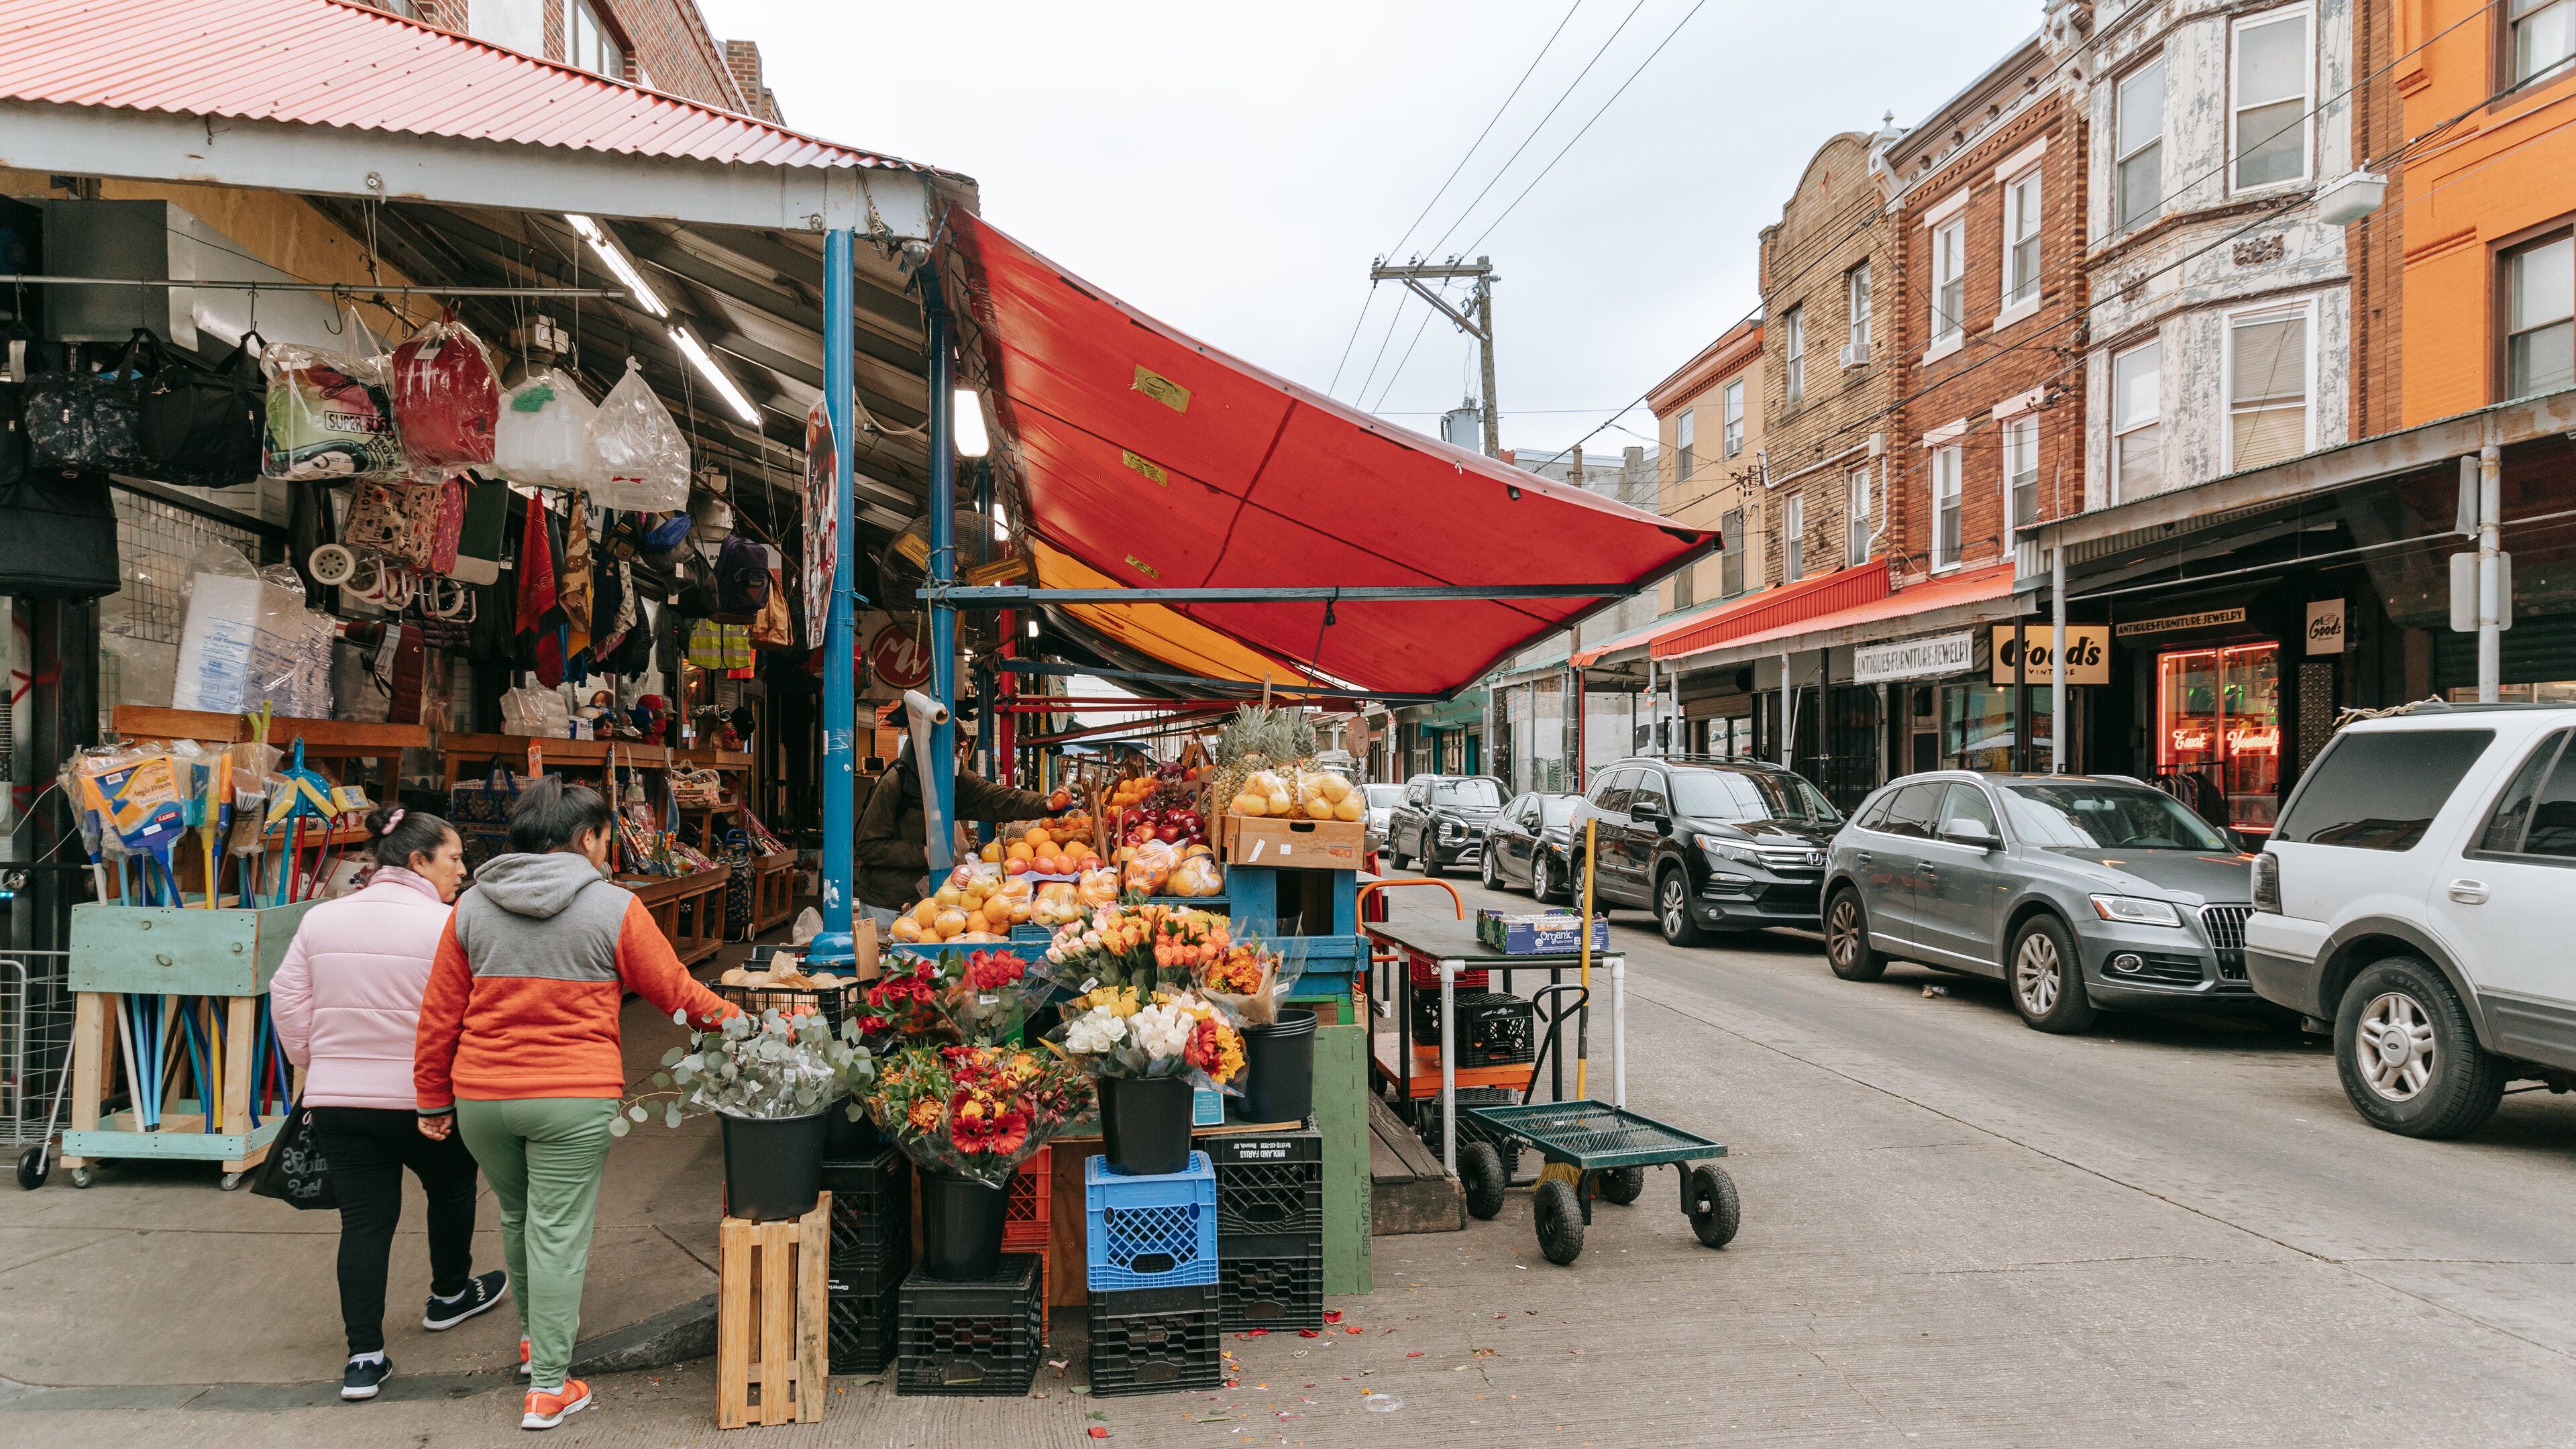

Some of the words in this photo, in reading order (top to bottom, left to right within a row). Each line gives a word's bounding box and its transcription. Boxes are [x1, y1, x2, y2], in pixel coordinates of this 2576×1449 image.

[329, 413, 362, 431] SUPER
[366, 417, 387, 433] SOF
[350, 443, 380, 452] NOBLE
[383, 445, 400, 454] QUA
[2171, 730, 2207, 750] Treat
[2226, 727, 2280, 756] Yourself
[133, 785, 152, 797] Angle
[150, 781, 172, 792] Broom
[139, 796, 156, 805] Balais
[159, 790, 174, 801] angle
[158, 811, 176, 822] LARGE
[1328, 847, 1353, 859] Dole
[1540, 930, 1574, 945] Organic
[1240, 1150, 1260, 1159] FARMS
[1260, 1149, 1285, 1158] MIDLAND
